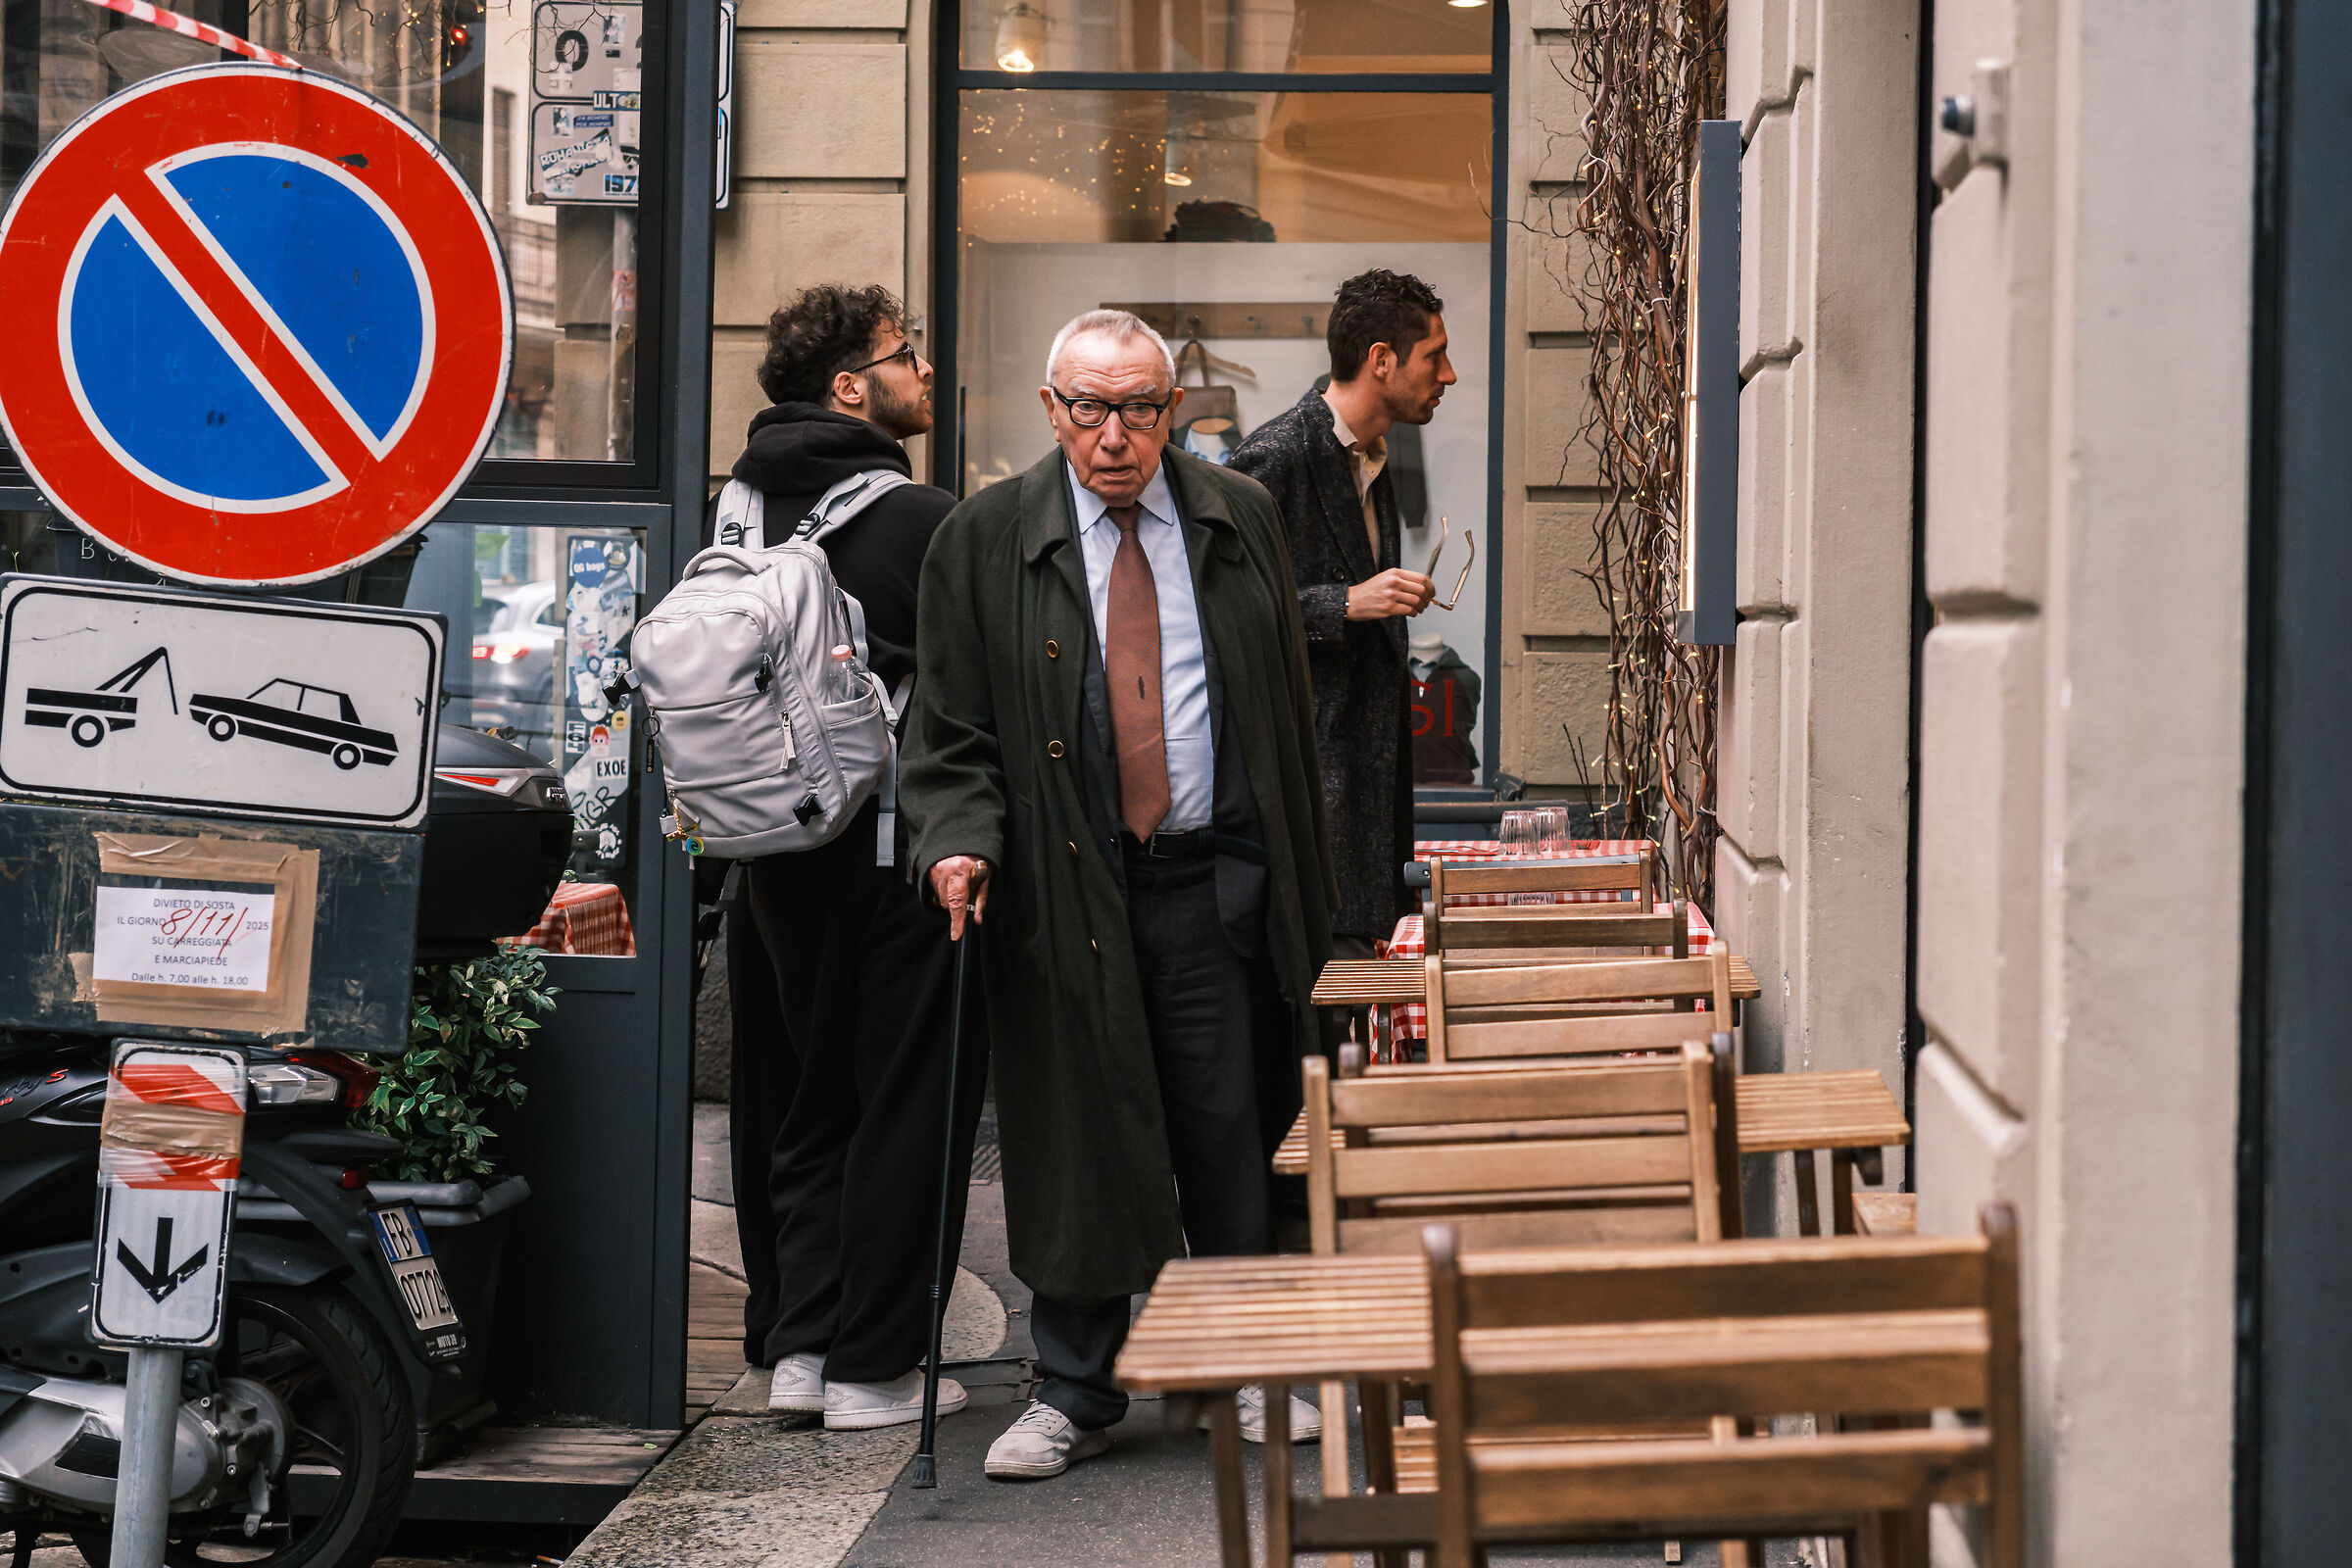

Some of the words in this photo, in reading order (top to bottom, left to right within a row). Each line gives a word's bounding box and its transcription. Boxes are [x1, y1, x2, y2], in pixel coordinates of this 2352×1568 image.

[605, 174, 639, 192] 197
[597, 760, 626, 777] EXOE
[153, 899, 191, 908] DIVIETO
[194, 900, 204, 908] DI
[206, 901, 235, 910] SOSTA
[117, 916, 125, 925] IL
[127, 916, 167, 926] GIORNO
[246, 921, 269, 930] 2025
[152, 936, 165, 946] SU
[167, 937, 231, 947] CARREGGIATA
[154, 955, 161, 963] E
[163, 956, 228, 966] MARCIAPIEDE
[131, 972, 155, 982] Dalle
[158, 973, 166, 983] h.
[170, 974, 190, 985] 7,00
[191, 974, 208, 984] alle
[211, 975, 220, 985] h.
[223, 976, 249, 987] 18,00
[46, 1068, 70, 1084] S
[381, 1212, 413, 1258] FB
